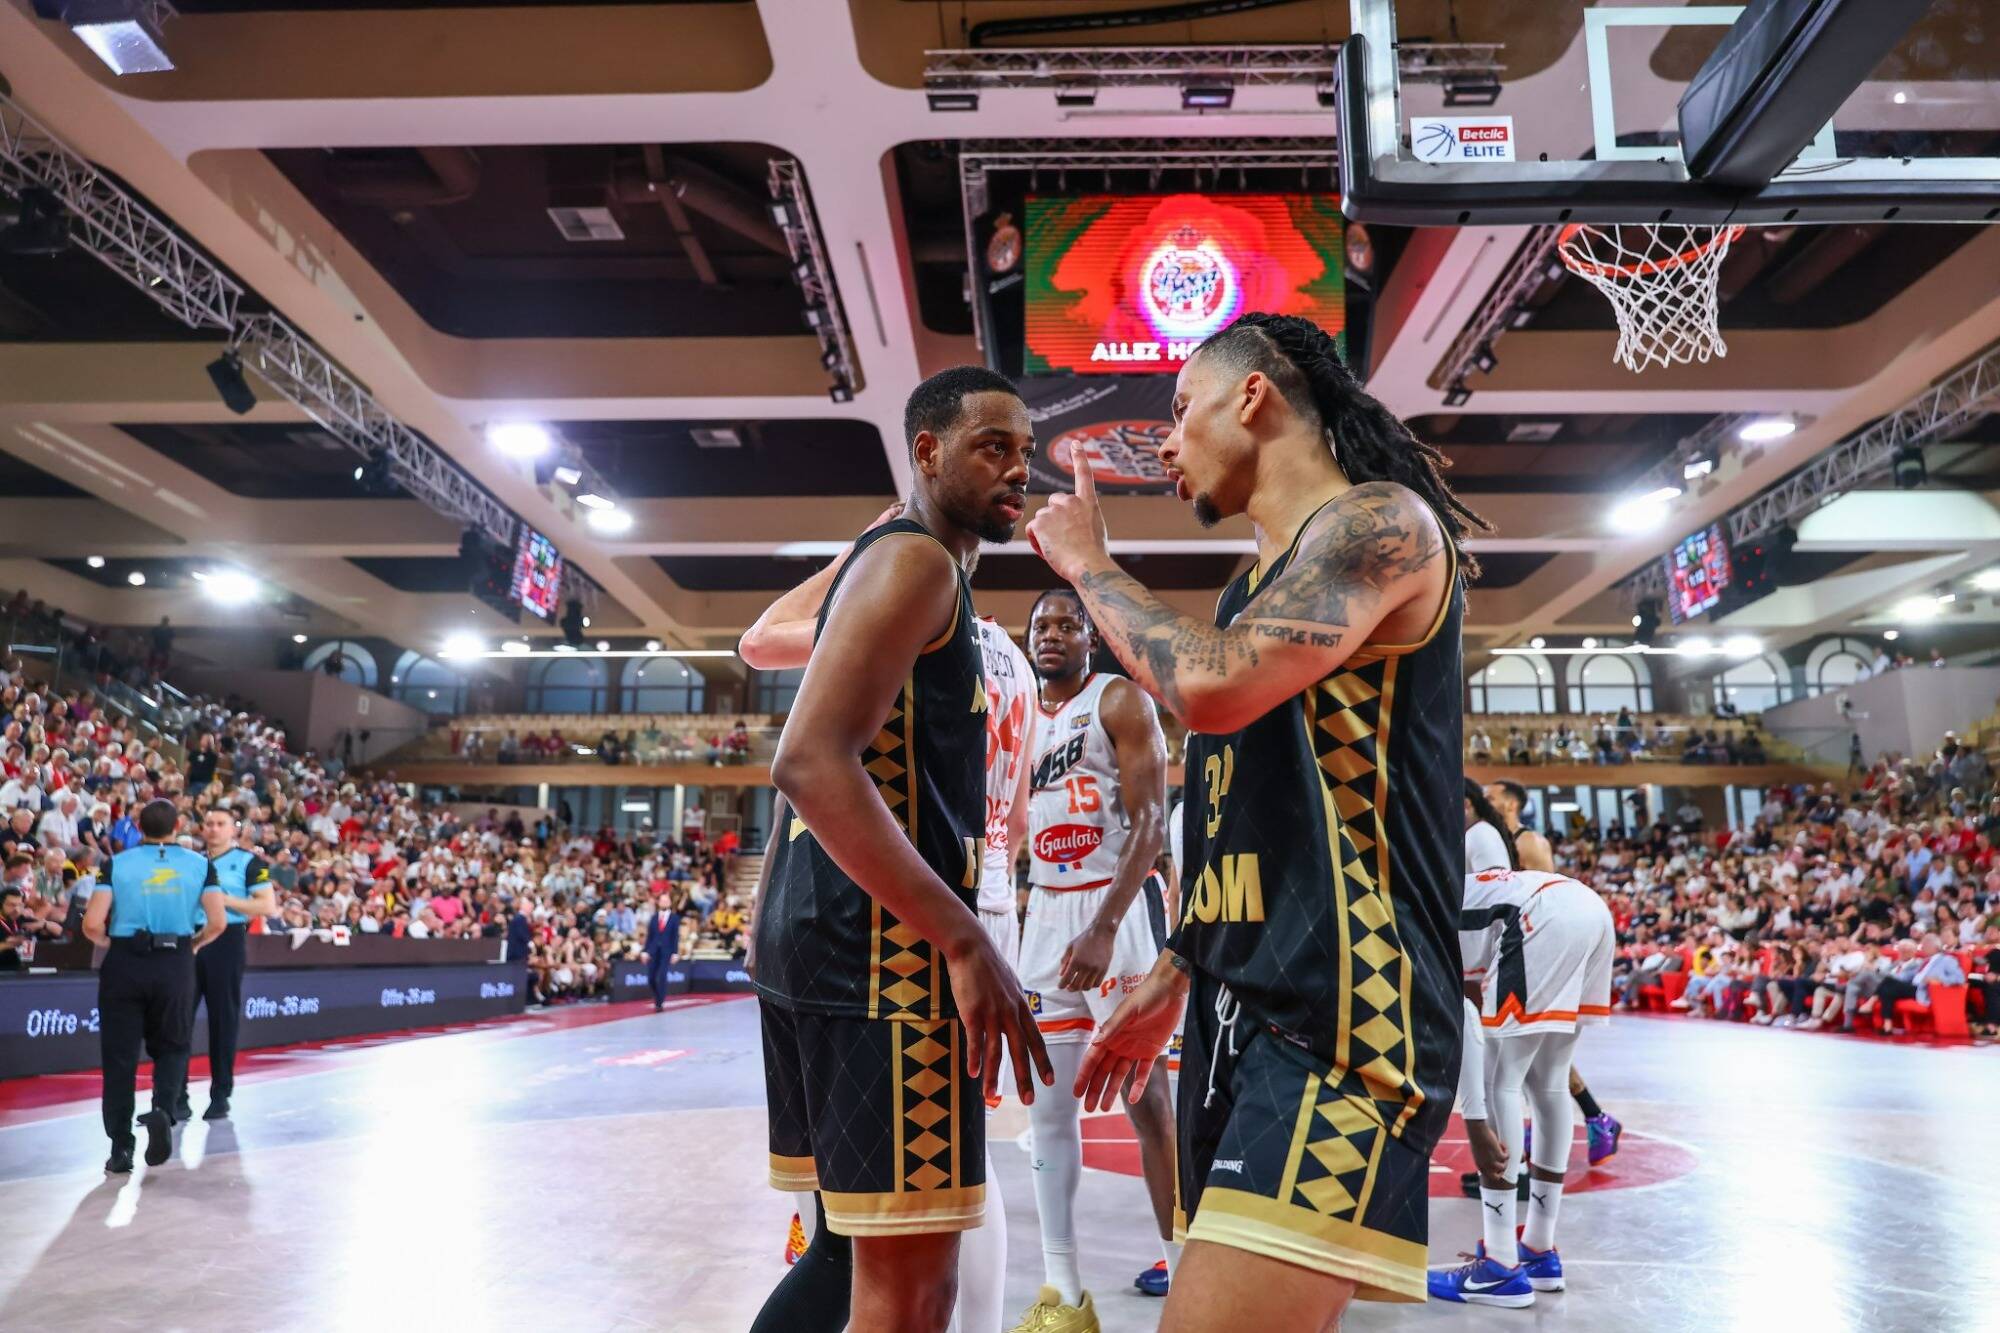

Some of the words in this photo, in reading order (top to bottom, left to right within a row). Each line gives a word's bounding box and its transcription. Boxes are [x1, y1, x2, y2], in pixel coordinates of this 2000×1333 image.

[1462, 128, 1504, 140] Betclic
[1463, 143, 1506, 157] ÉLITE
[1090, 342, 1161, 361] ALLEZ
[1256, 623, 1307, 645] PEOPLE
[1310, 632, 1343, 648] FIRST
[1030, 731, 1086, 789] MSB
[1065, 775, 1100, 814] 15
[1040, 829, 1101, 859] Gaulois
[245, 996, 278, 1019] Offre
[27, 1009, 78, 1037] Offre
[80, 1007, 100, 1033] -2
